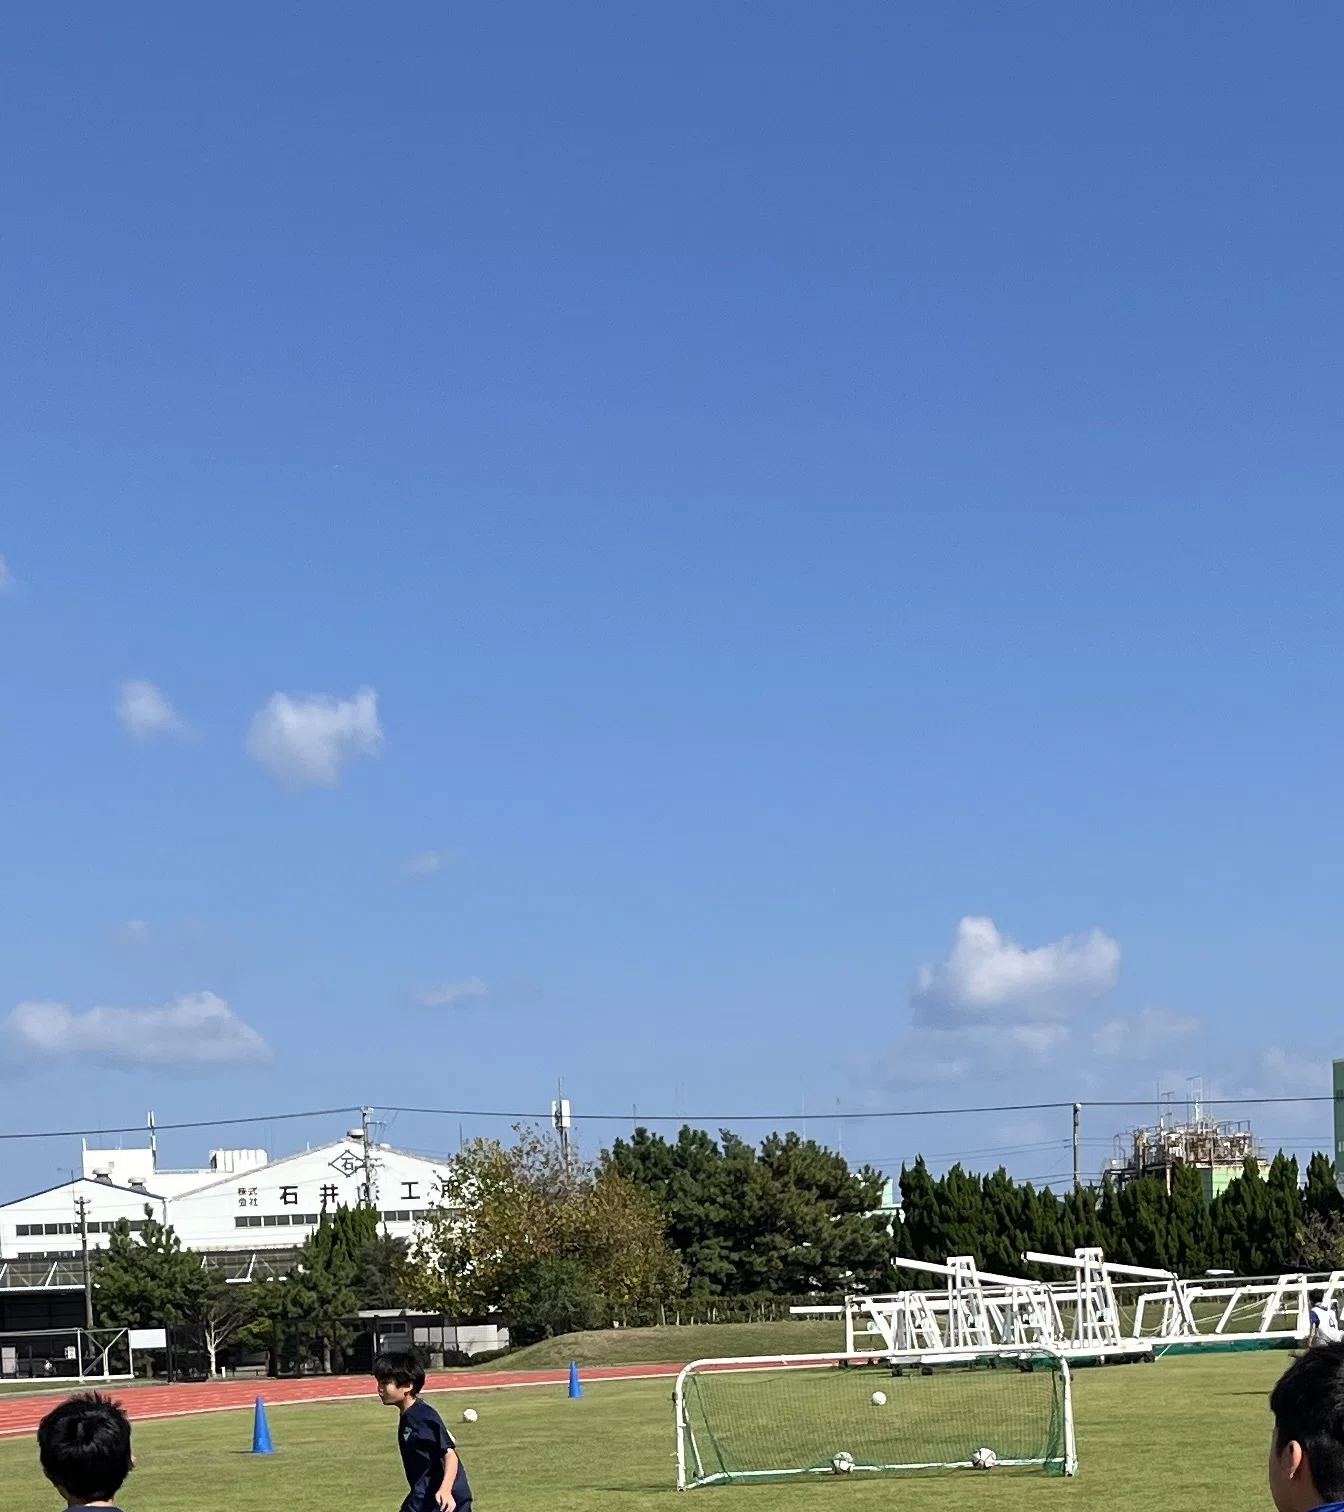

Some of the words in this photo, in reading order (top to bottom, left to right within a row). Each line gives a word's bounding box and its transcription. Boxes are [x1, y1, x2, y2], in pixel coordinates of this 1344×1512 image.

[341, 1157, 354, 1171] 石
[278, 1180, 460, 1205] 石井工
